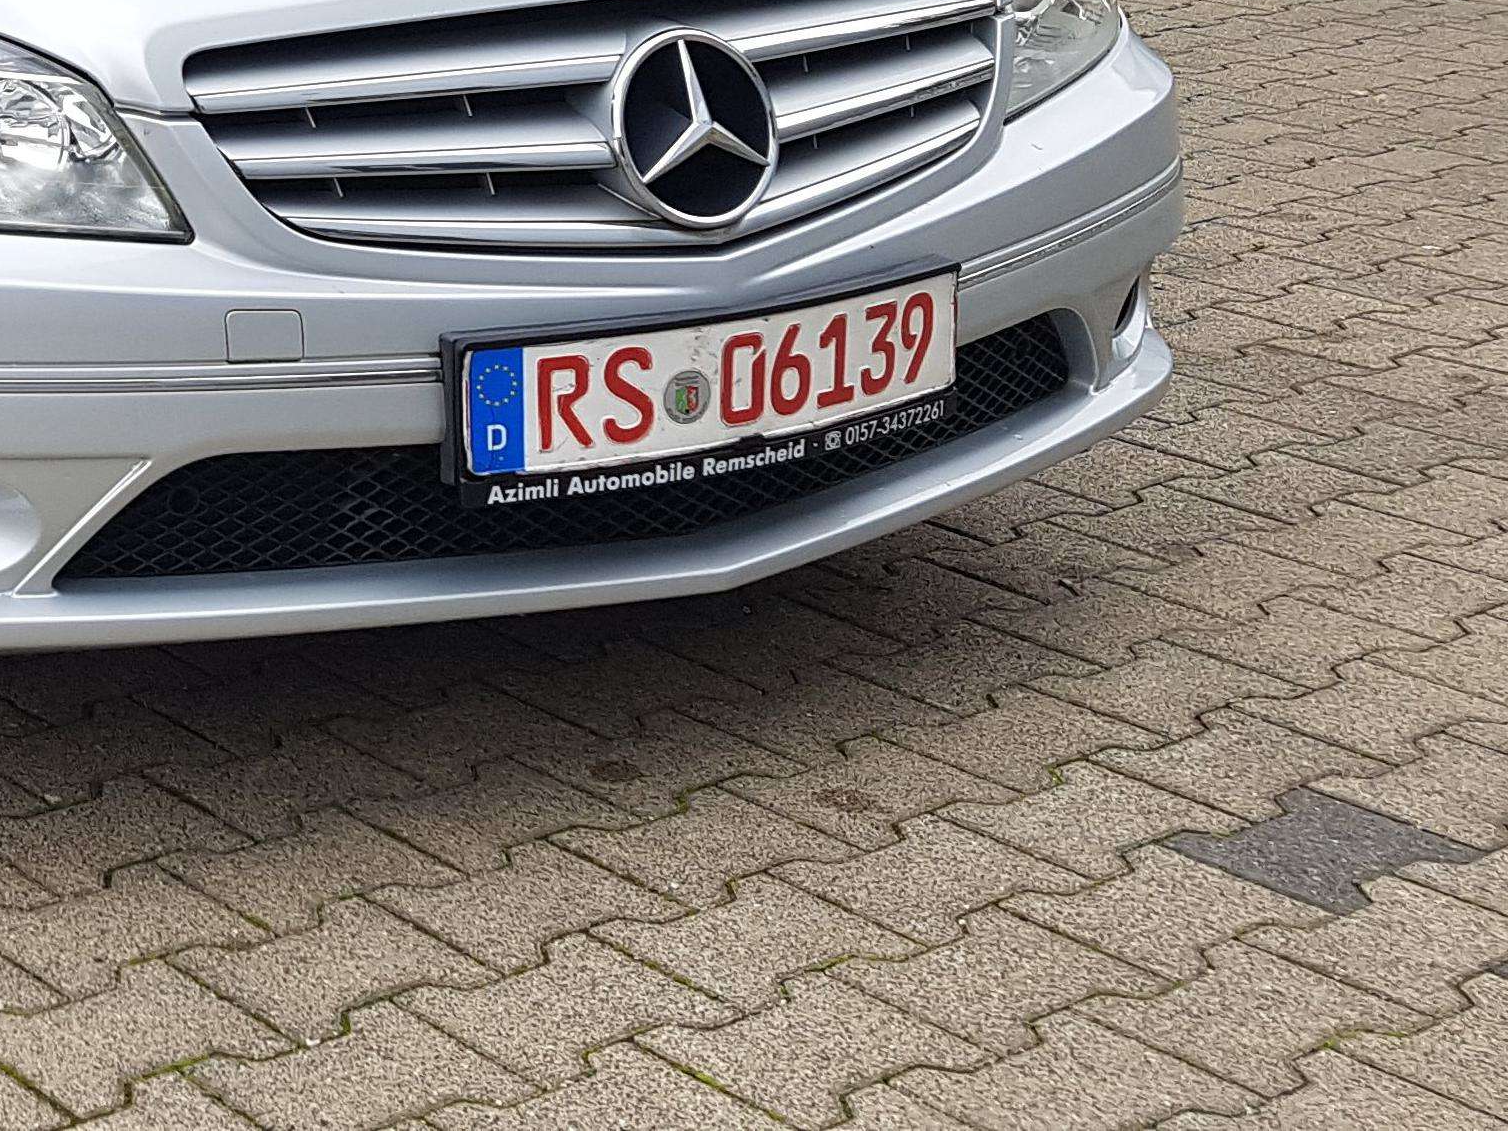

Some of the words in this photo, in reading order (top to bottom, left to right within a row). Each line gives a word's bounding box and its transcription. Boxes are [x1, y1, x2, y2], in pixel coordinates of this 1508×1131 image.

[536, 346, 656, 452] RS
[719, 291, 935, 427] 06139
[486, 423, 508, 452] D
[486, 478, 560, 505] Azimli
[566, 461, 696, 496] Automobile
[702, 438, 806, 477] Remscheid
[844, 399, 945, 446] 0157-34372261
